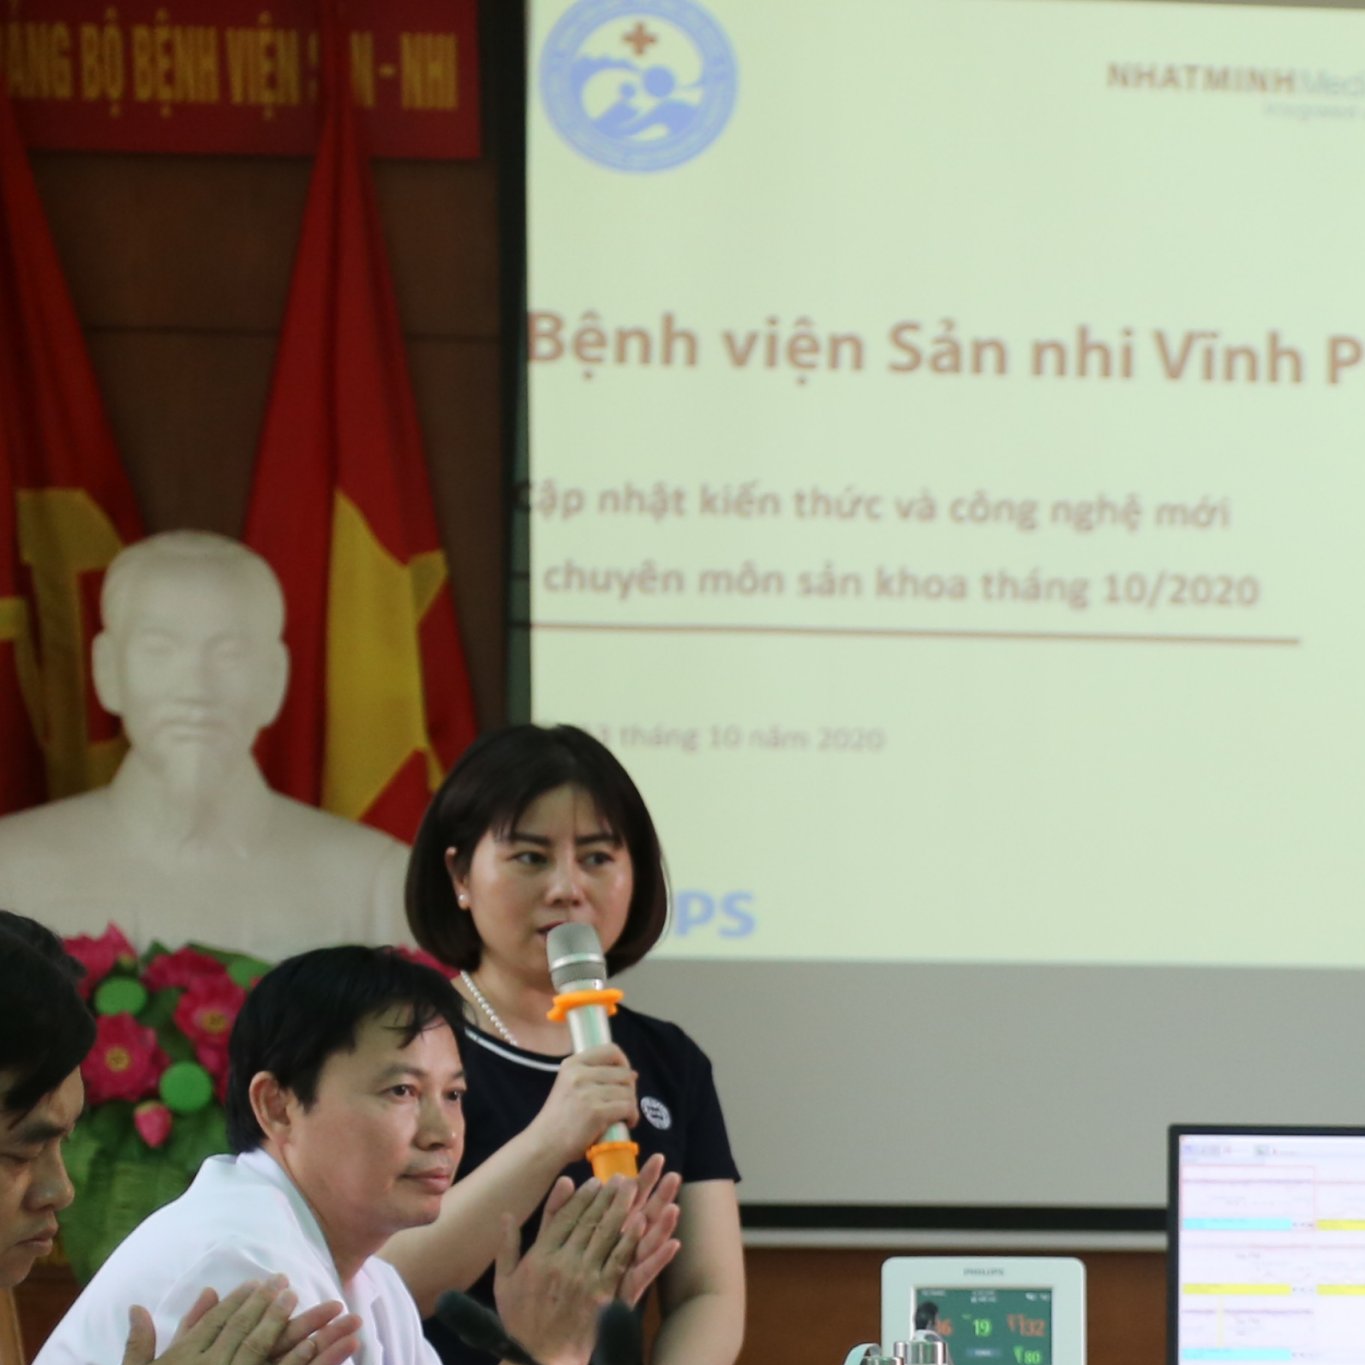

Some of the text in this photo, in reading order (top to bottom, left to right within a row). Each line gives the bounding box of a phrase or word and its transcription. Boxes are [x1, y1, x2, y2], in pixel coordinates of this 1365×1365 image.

[80, 7, 124, 118] BỘ
[132, 7, 218, 118] BỆNH
[225, 10, 298, 120] VIỆN
[401, 32, 458, 110] NHI
[528, 310, 699, 382] Bệnh
[721, 316, 865, 386] viện
[887, 317, 1009, 376] Sản
[1031, 323, 1134, 379] nhi
[1152, 329, 1304, 385] Vĩnh
[597, 481, 687, 522] nhật
[700, 479, 782, 519] kiến
[794, 483, 883, 520] thức
[894, 486, 937, 522] và
[949, 489, 1040, 533] công
[1050, 493, 1143, 533] nghệ
[1155, 495, 1231, 528] mới
[543, 559, 1262, 611] chuyên môn sản khoa tháng 10/2020
[618, 722, 700, 752] tháng
[710, 724, 740, 749] 10
[817, 726, 887, 752] 2020
[674, 889, 757, 939] PS
